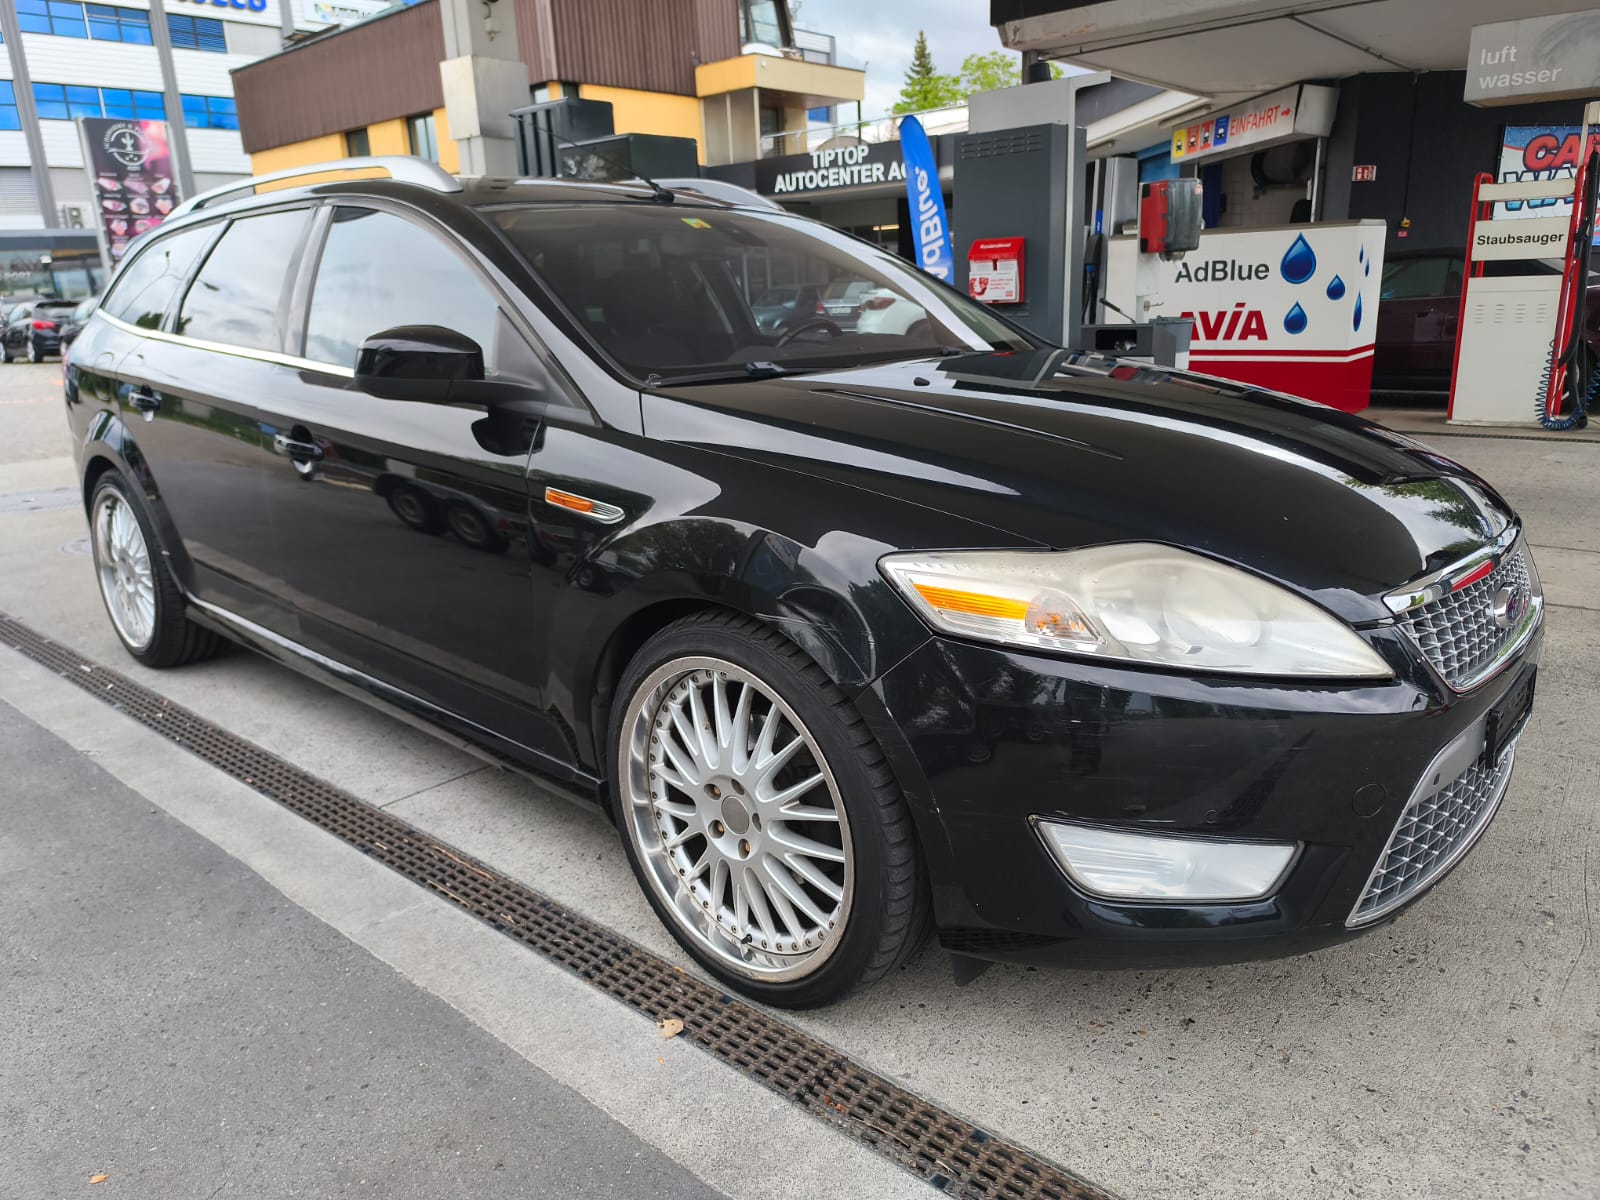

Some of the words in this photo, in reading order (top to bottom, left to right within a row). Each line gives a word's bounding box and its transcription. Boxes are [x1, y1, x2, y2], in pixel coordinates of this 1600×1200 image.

[1480, 45, 1518, 65] luft
[1479, 67, 1562, 89] wasser
[1229, 105, 1281, 137] EINFAHRT
[809, 145, 870, 169] TIPTOP
[774, 163, 885, 193] AUTOCENTER
[1477, 233, 1565, 246] Staubsauger
[1174, 259, 1270, 284] AdBlue
